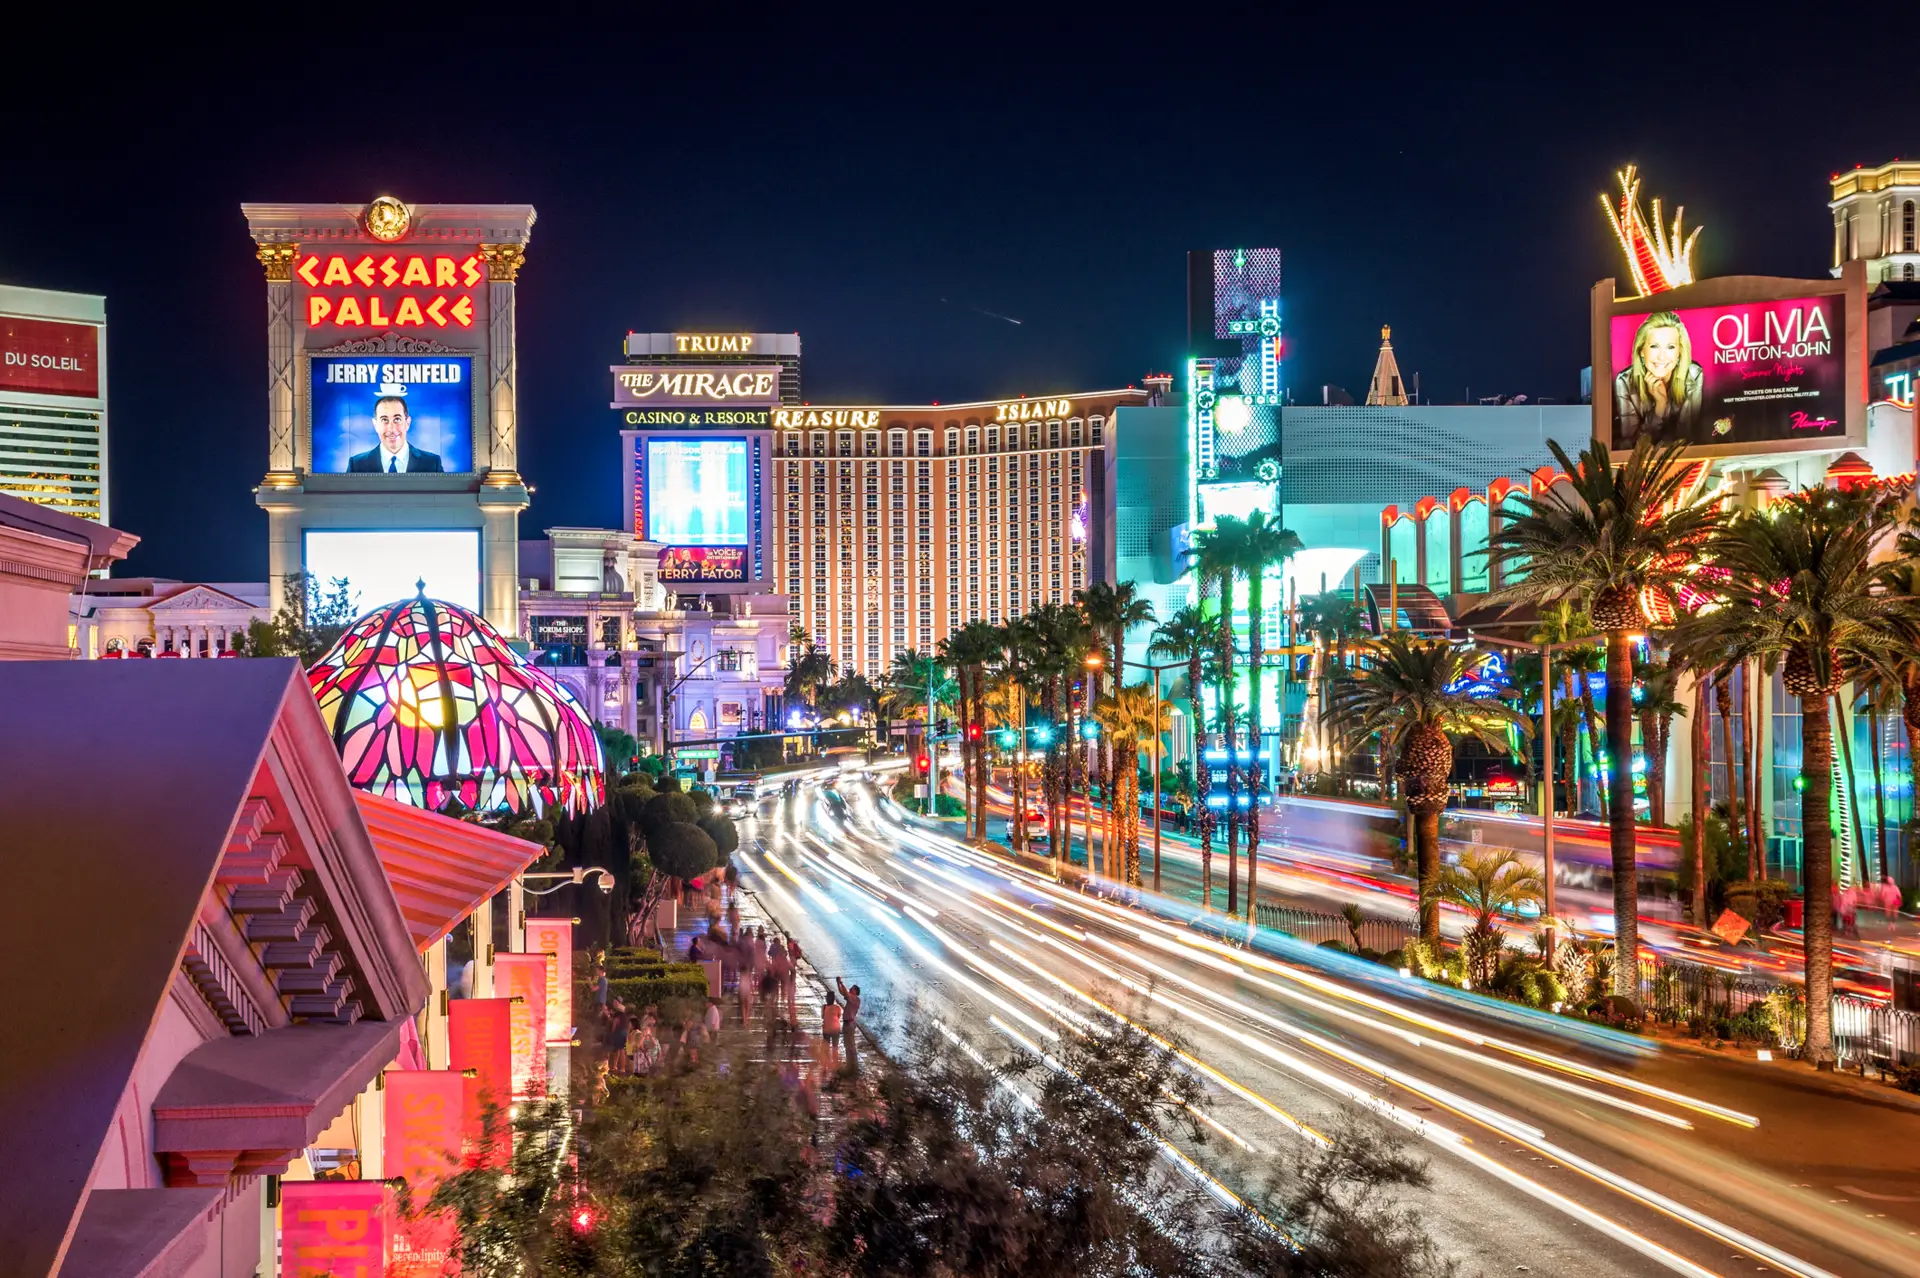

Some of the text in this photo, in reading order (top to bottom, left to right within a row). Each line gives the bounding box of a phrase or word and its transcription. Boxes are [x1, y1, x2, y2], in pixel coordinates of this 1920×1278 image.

[297, 255, 482, 288] CAESARS
[310, 295, 472, 327] PALACE
[1713, 306, 1831, 350] OLIVIA
[676, 336, 752, 352] TRUMP
[1714, 341, 1831, 364] NEWTON-JOHN
[5, 352, 82, 371] DU SOLEIL
[1774, 361, 1804, 382] Nights
[326, 364, 461, 384] JERRY SEINFELD
[620, 373, 774, 399] THE MIRAGE
[626, 411, 768, 425] CASINO & RESORT
[770, 399, 1071, 429] REASURE ISLAND
[712, 548, 736, 556] VOICE
[658, 568, 742, 579] TERRY FATOR
